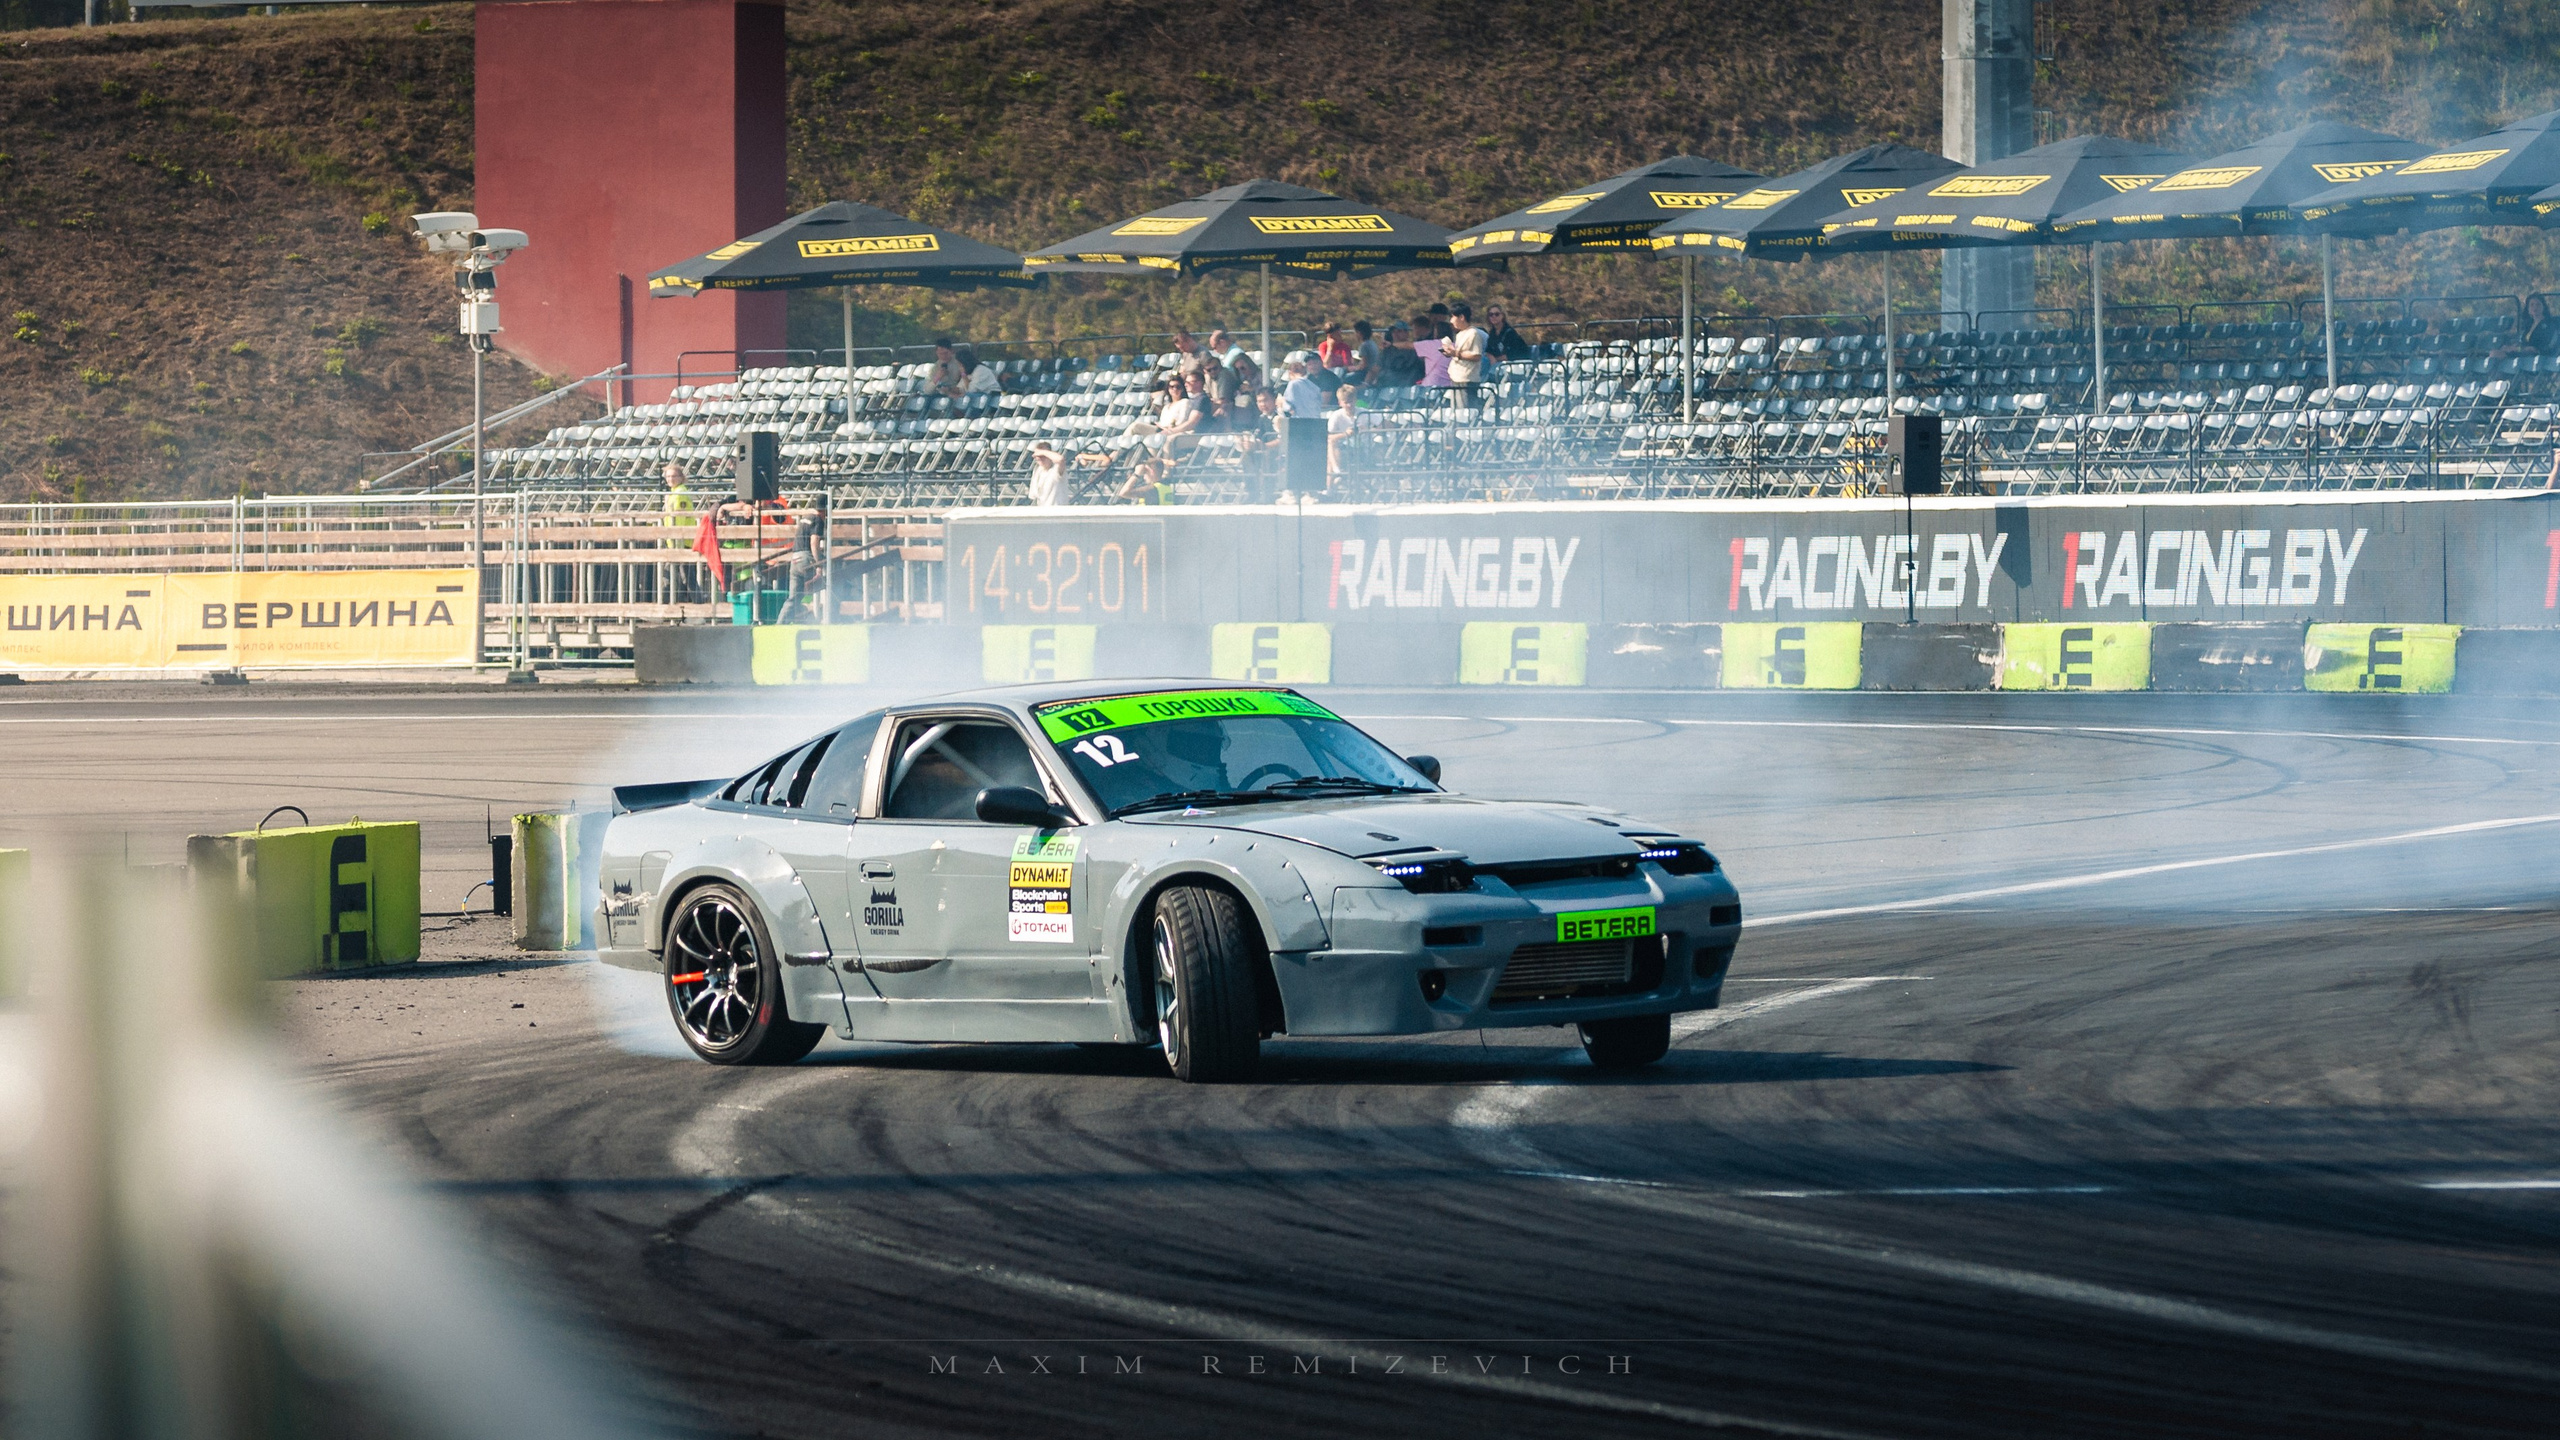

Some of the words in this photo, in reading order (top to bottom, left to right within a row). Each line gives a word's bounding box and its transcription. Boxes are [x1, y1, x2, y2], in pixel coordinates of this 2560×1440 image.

[2327, 165, 2394, 179] DYN
[1661, 195, 1729, 206] DYN
[806, 237, 929, 255] DYNAMI:T
[960, 542, 1150, 614] 14:32:01
[7, 604, 143, 631] ШИНА
[202, 600, 455, 629] ВЕРШИНА
[0, 644, 41, 654] МПЛЕКС
[1139, 697, 1259, 719] ГОРОШКО
[1069, 711, 1106, 728] 12
[1072, 734, 1140, 768] 12
[1013, 867, 1068, 883] DYNAMI:T
[1012, 889, 1063, 901] Blockchain
[1012, 901, 1044, 913] Sports
[864, 906, 905, 927] GORILLA
[1023, 922, 1067, 933] TOTACHI
